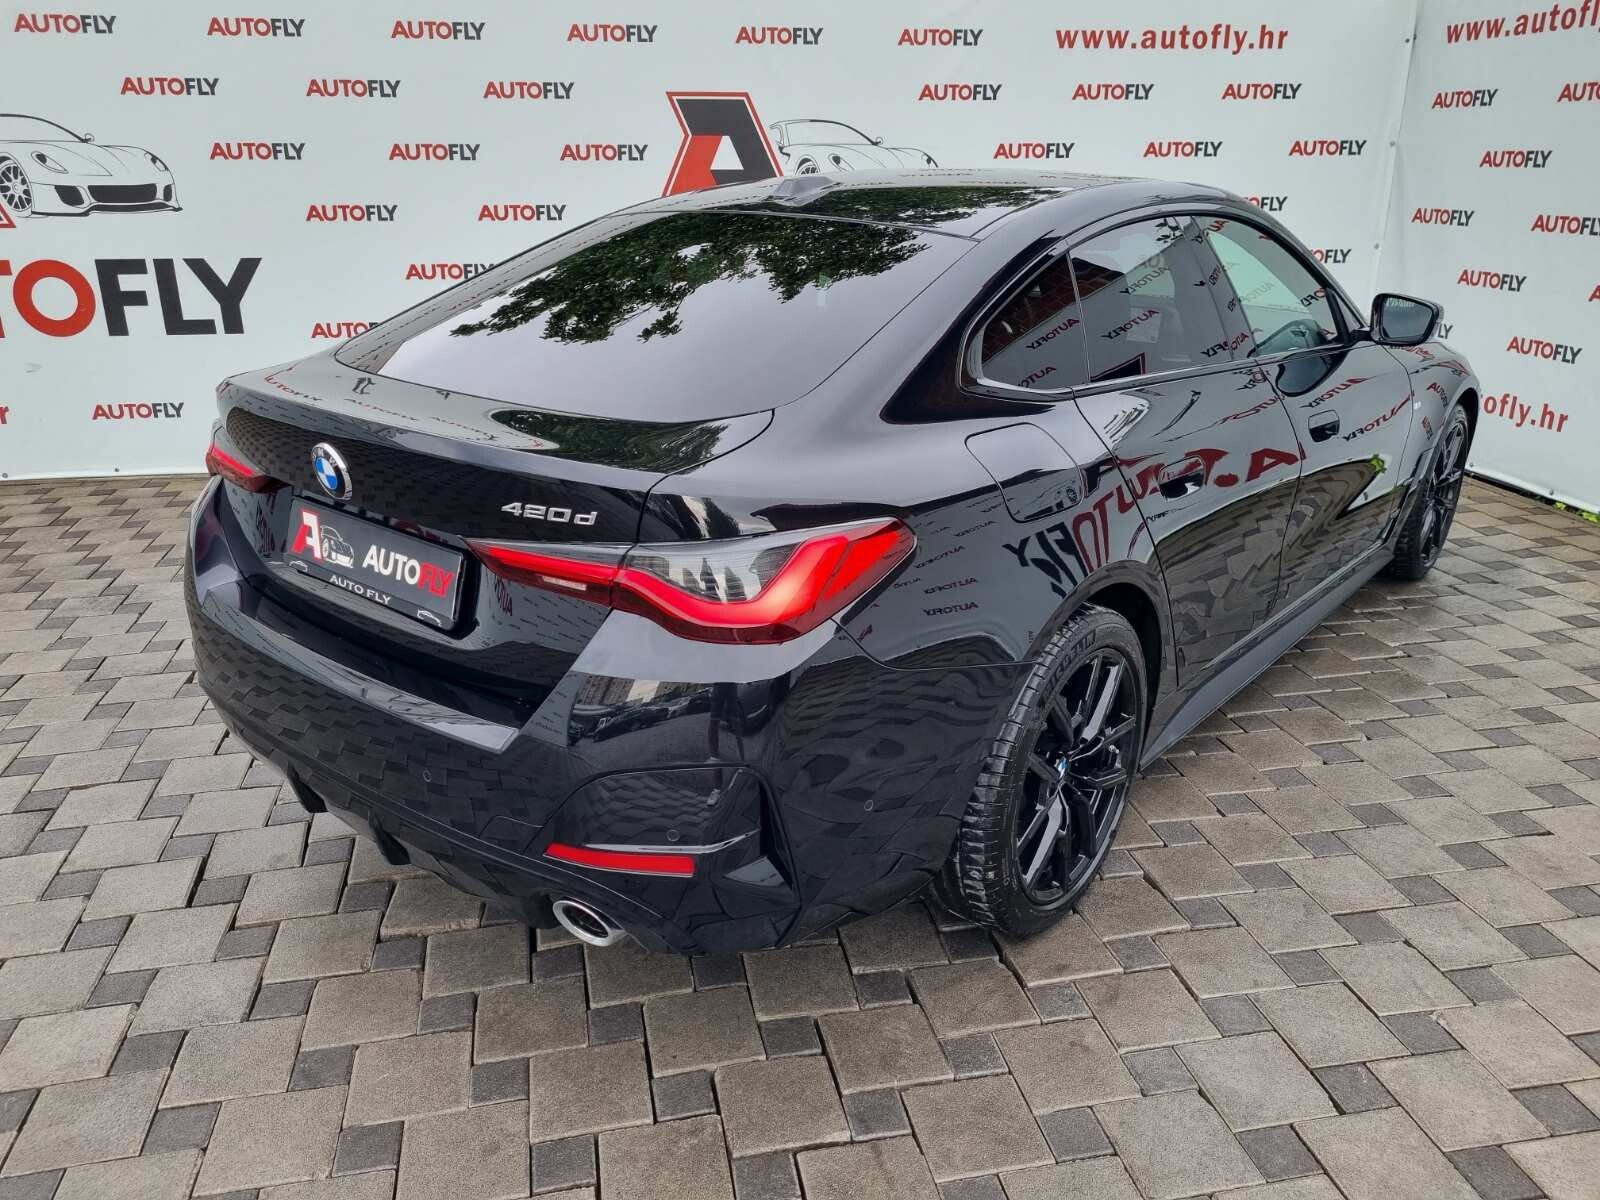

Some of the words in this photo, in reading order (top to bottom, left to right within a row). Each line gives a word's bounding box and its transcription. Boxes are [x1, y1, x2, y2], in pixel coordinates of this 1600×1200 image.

[15, 14, 116, 34] AUTOFLY
[208, 17, 305, 38] AUTOFLY
[391, 21, 485, 41] AUTOFLY
[1447, 0, 1600, 43] www.autofl
[568, 24, 658, 43] AUTOFLY
[736, 27, 823, 46] AUTOFLY
[898, 29, 983, 47] AUTOFLY
[1056, 24, 1288, 55] www.autofly.hr
[121, 77, 219, 96] AUTOFLY
[306, 79, 400, 98] AUTOFLY
[484, 81, 574, 100] AUTOFLY
[918, 84, 1002, 101] AUTOFLY
[1072, 84, 1154, 101] AUTOFLY
[1222, 83, 1302, 100] AUTOFLY
[1432, 89, 1498, 109] AUTOFLY
[210, 143, 305, 161] AUTOFLY
[389, 144, 480, 161] AUTOFLY
[560, 144, 648, 162] AUTOFLY
[994, 143, 1075, 160] AUTOFLY
[1144, 141, 1223, 158] AUTOFLY
[1289, 140, 1367, 157] AUTOFLY
[1480, 150, 1552, 169] AUTOFLY
[306, 205, 397, 222] AUTOFLY
[478, 205, 566, 222] AUTOFLY
[1412, 208, 1474, 227] AUTOFLY
[1458, 270, 1526, 292] AUTOFLY
[1507, 337, 1582, 364] AUTOFLY
[92, 402, 184, 421] AUTOFLY
[501, 502, 598, 526] 420d
[363, 544, 454, 598] AUTOFLY
[330, 575, 364, 595] AUTO
[366, 590, 391, 605] FLY
